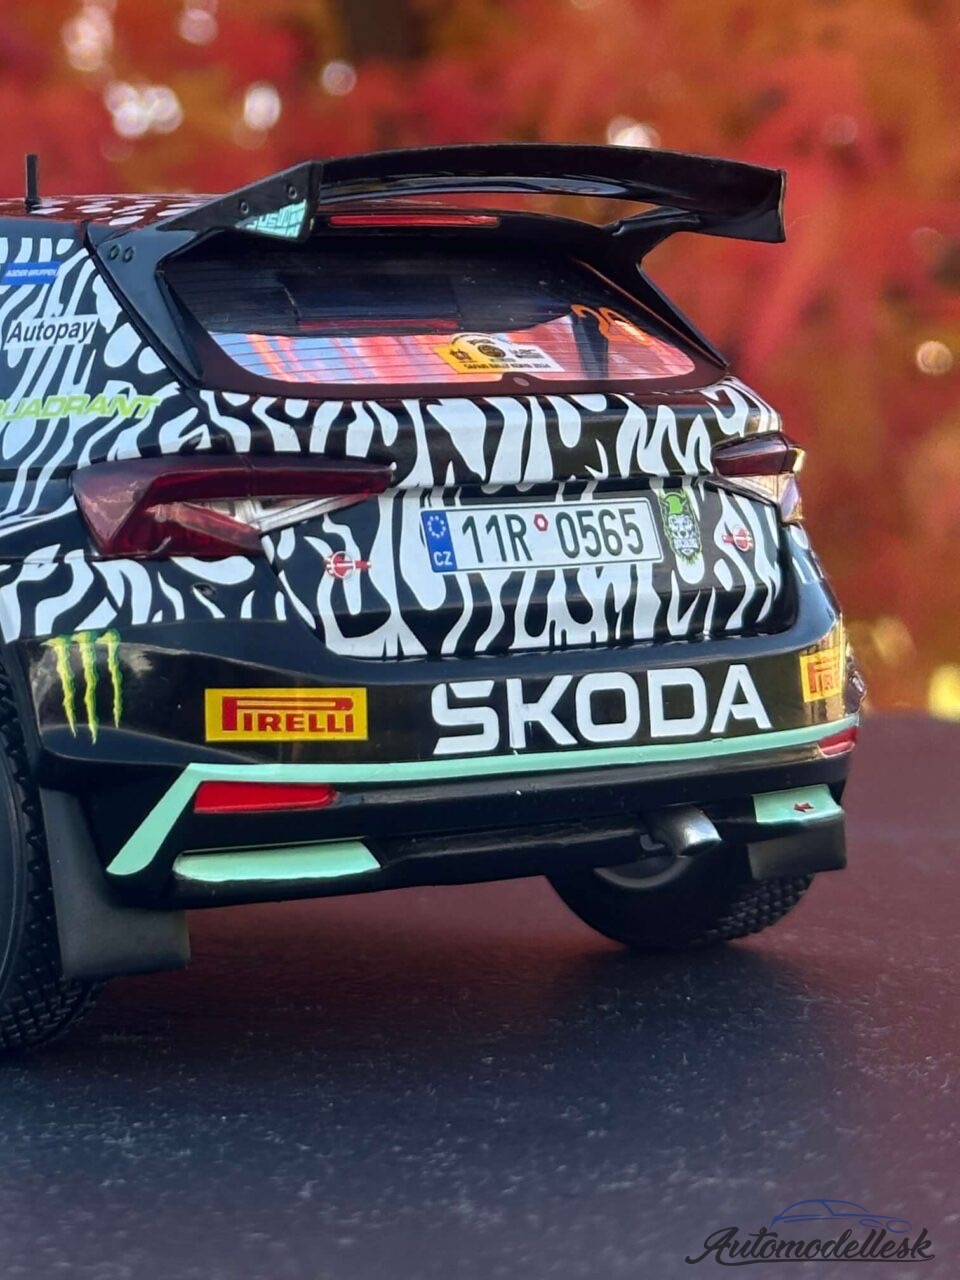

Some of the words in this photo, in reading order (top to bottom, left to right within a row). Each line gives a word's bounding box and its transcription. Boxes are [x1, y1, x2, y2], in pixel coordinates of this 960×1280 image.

[7, 320, 96, 344] Autopay
[461, 513, 533, 563] 11R
[555, 508, 644, 559] 0565
[433, 551, 453, 566] CZ
[222, 696, 354, 733] PIRELLI
